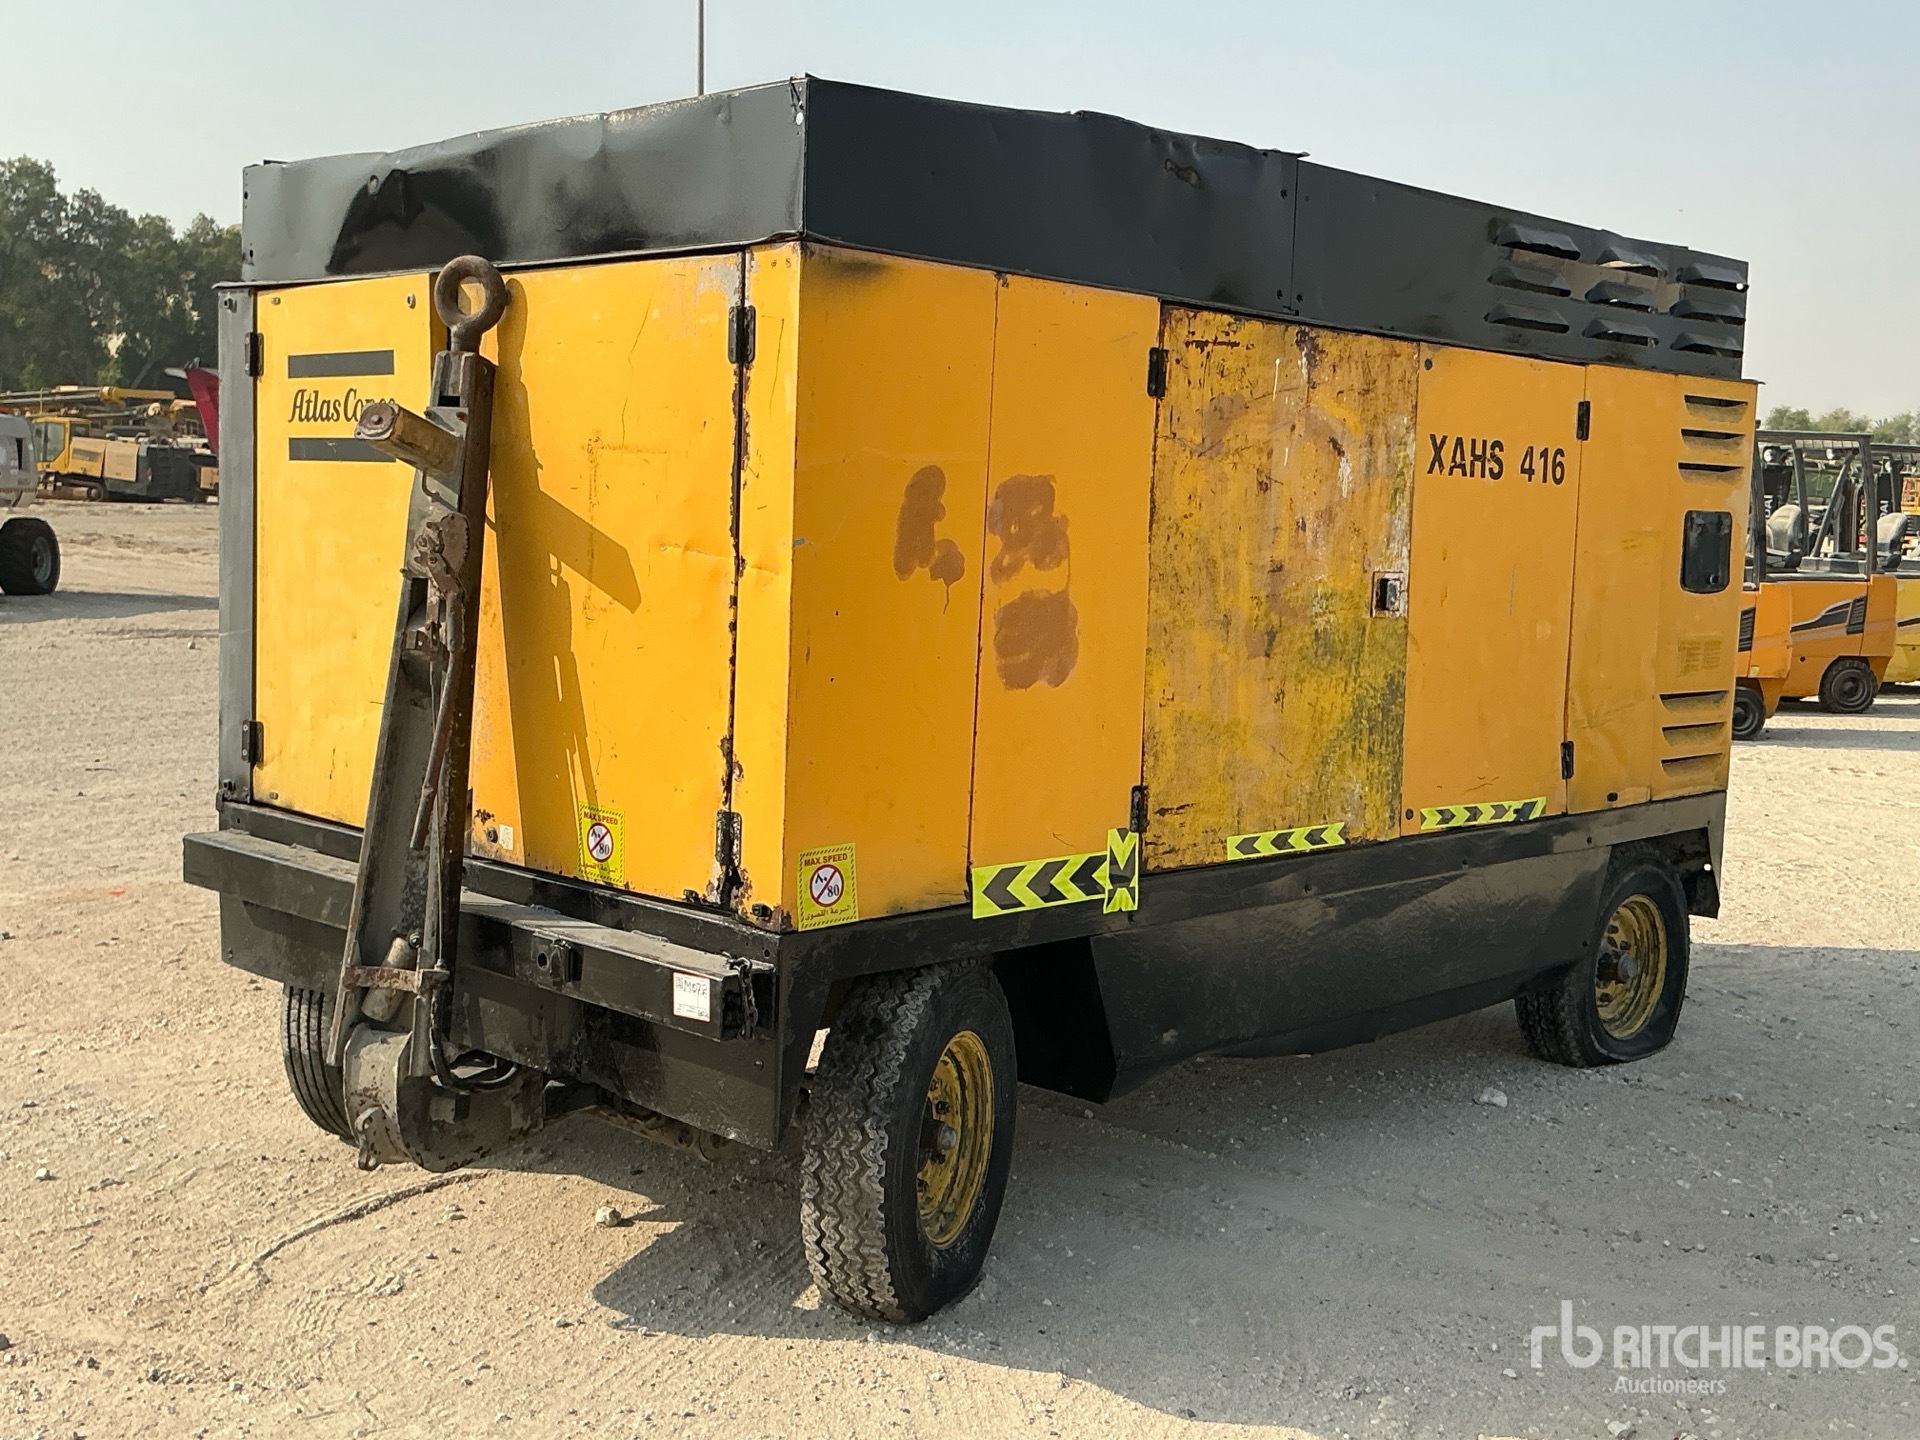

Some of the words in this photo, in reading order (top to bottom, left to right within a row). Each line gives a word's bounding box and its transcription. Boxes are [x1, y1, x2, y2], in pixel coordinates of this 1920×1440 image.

[288, 389, 341, 423] Atlas
[1427, 433, 1504, 480] XAHS
[1520, 446, 1565, 485] 416
[598, 814, 618, 826] SPEED
[598, 842, 610, 856] 80
[822, 853, 848, 864] SPEED
[827, 884, 840, 898] 80
